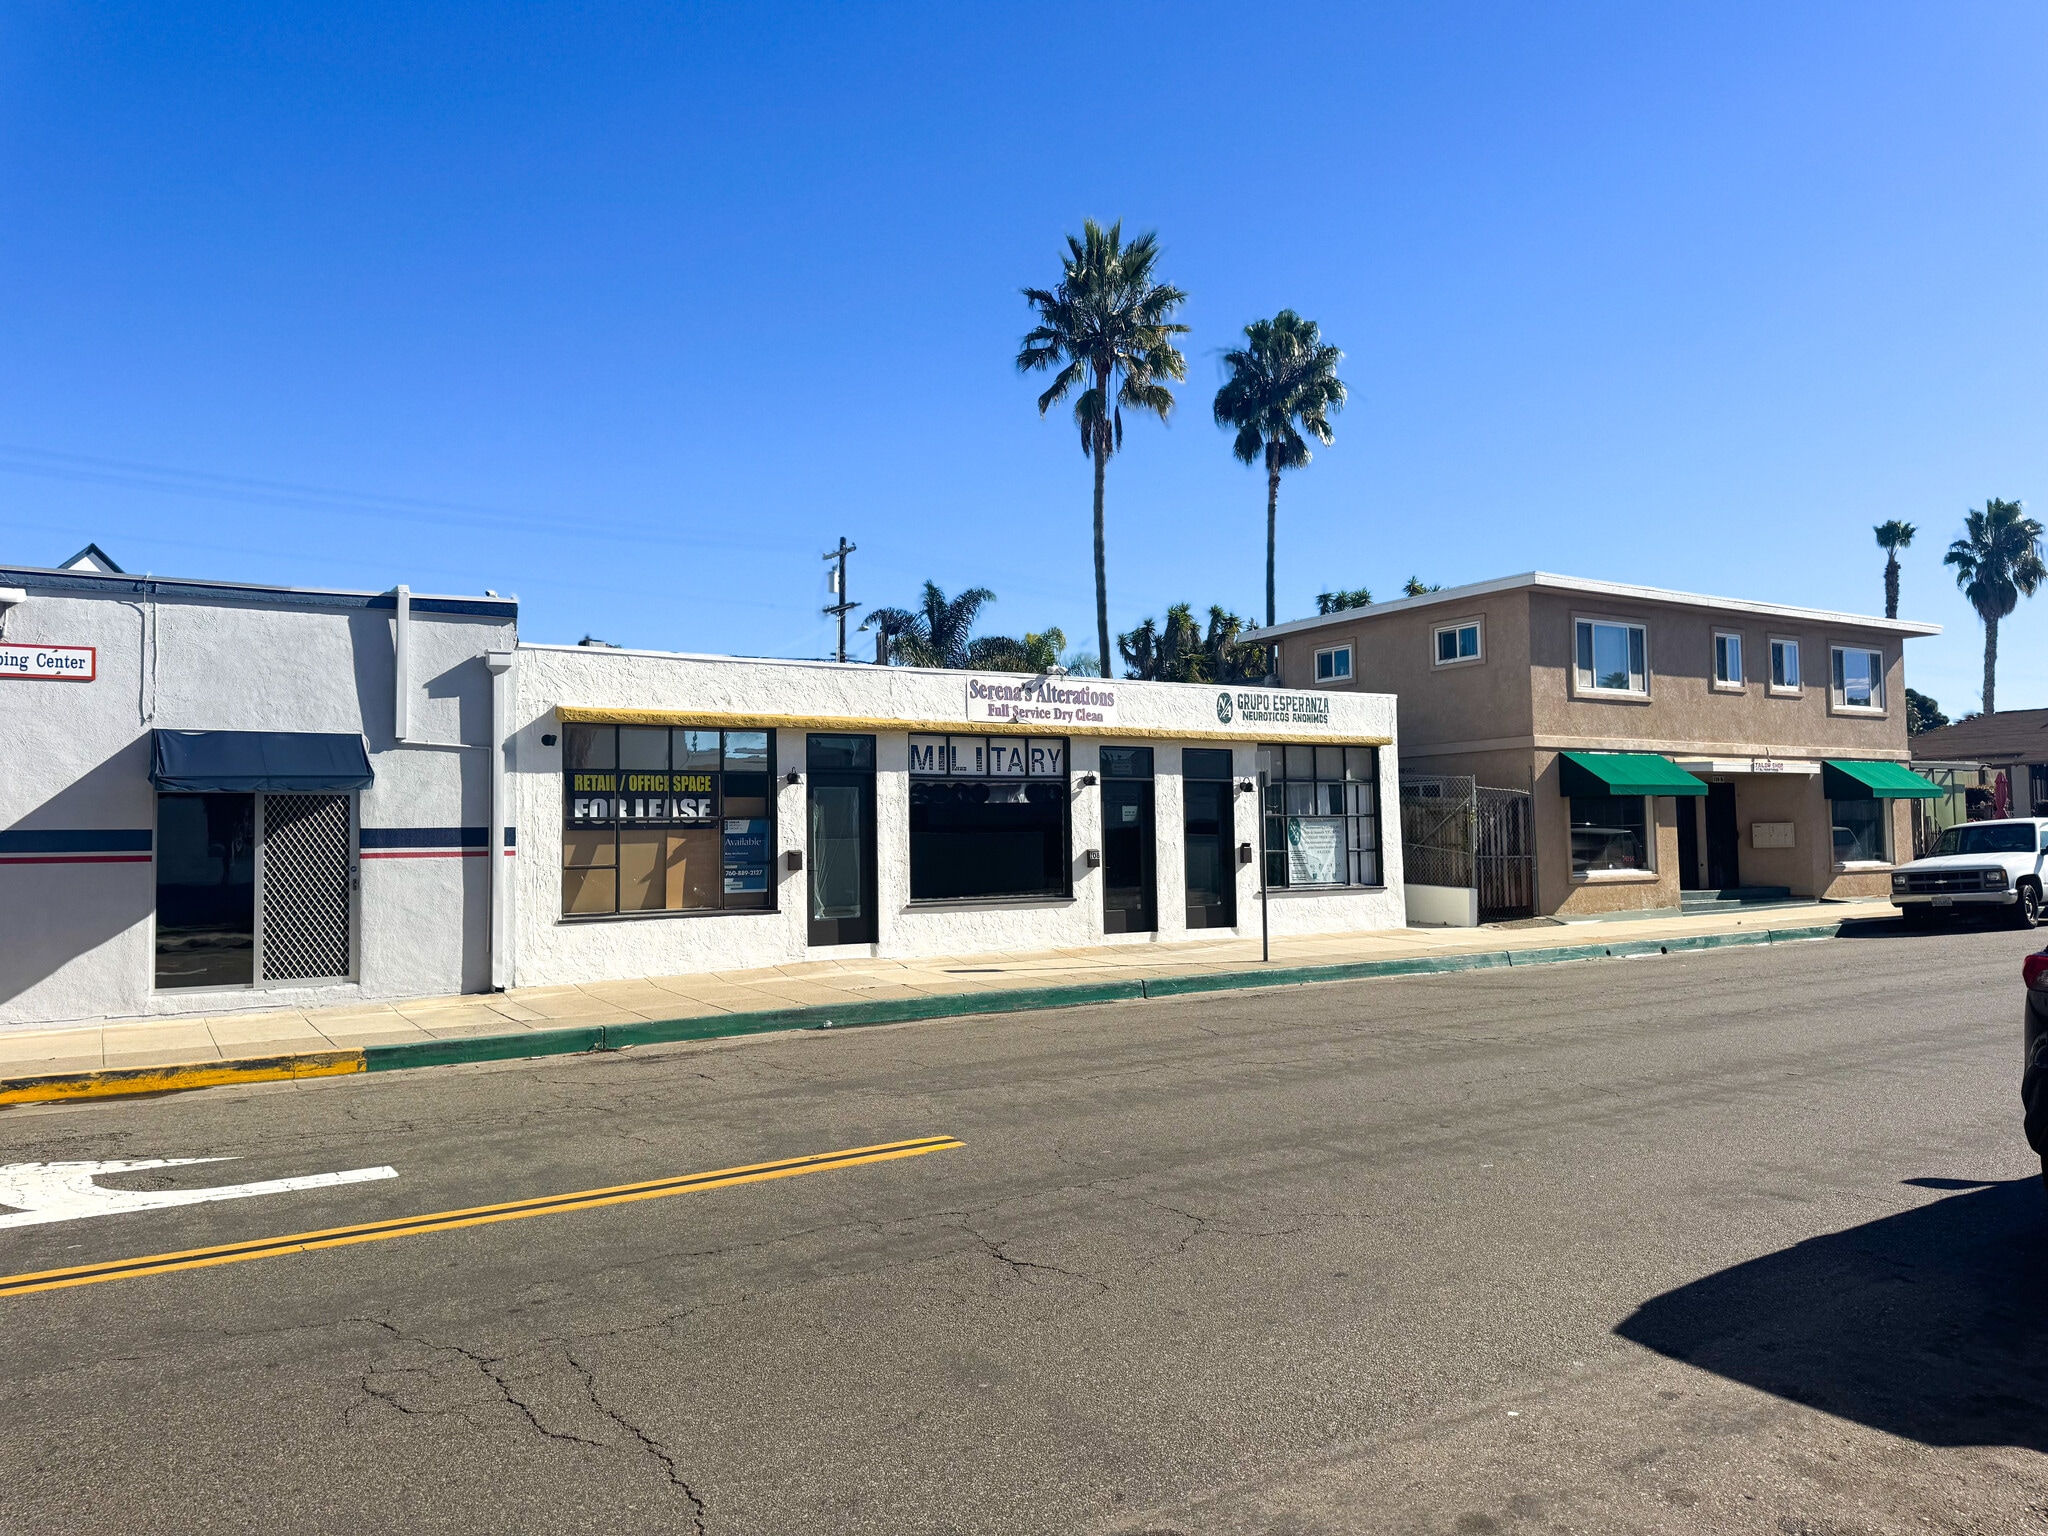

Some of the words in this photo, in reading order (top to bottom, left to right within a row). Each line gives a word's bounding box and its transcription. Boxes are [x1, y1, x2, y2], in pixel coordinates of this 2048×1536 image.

[36, 653, 86, 669] Center
[970, 679, 1032, 702] Serena's
[1036, 683, 1115, 707] Alterations
[1237, 693, 1269, 711] GRUPO
[1273, 695, 1330, 714] ESPERANZA
[988, 704, 1010, 718] Full
[1013, 705, 1051, 719] Service
[1053, 708, 1073, 723] Dry
[1076, 709, 1103, 723] Clean
[1242, 710, 1290, 723] NEUROTICOS
[1292, 713, 1328, 724] ANONIMOS
[911, 744, 1061, 773] MILITARY
[574, 775, 616, 792] RETAIL
[620, 775, 626, 792] /
[673, 776, 711, 792] SPACE
[574, 798, 627, 824] FOR
[635, 798, 711, 824] LEASE
[725, 838, 762, 846] Available
